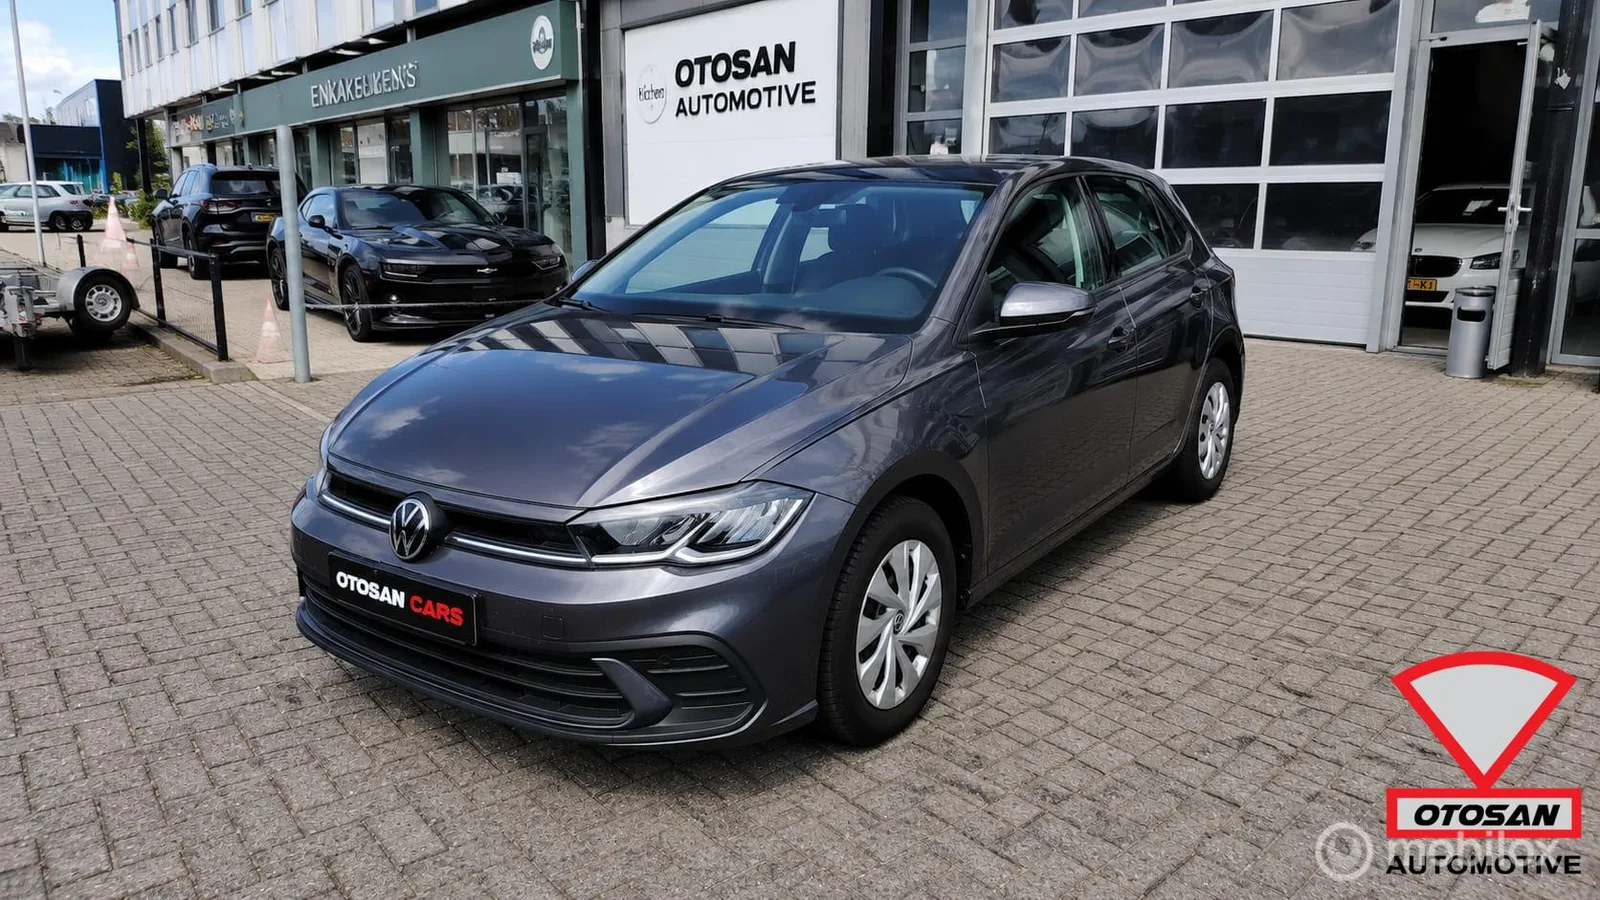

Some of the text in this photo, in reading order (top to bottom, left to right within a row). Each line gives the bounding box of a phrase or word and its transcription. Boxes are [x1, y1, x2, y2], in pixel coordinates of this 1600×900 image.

[675, 41, 796, 88] OTOSAN
[675, 81, 816, 117] AUTOMOTIVE
[336, 571, 464, 626] OTOSAN CARS
